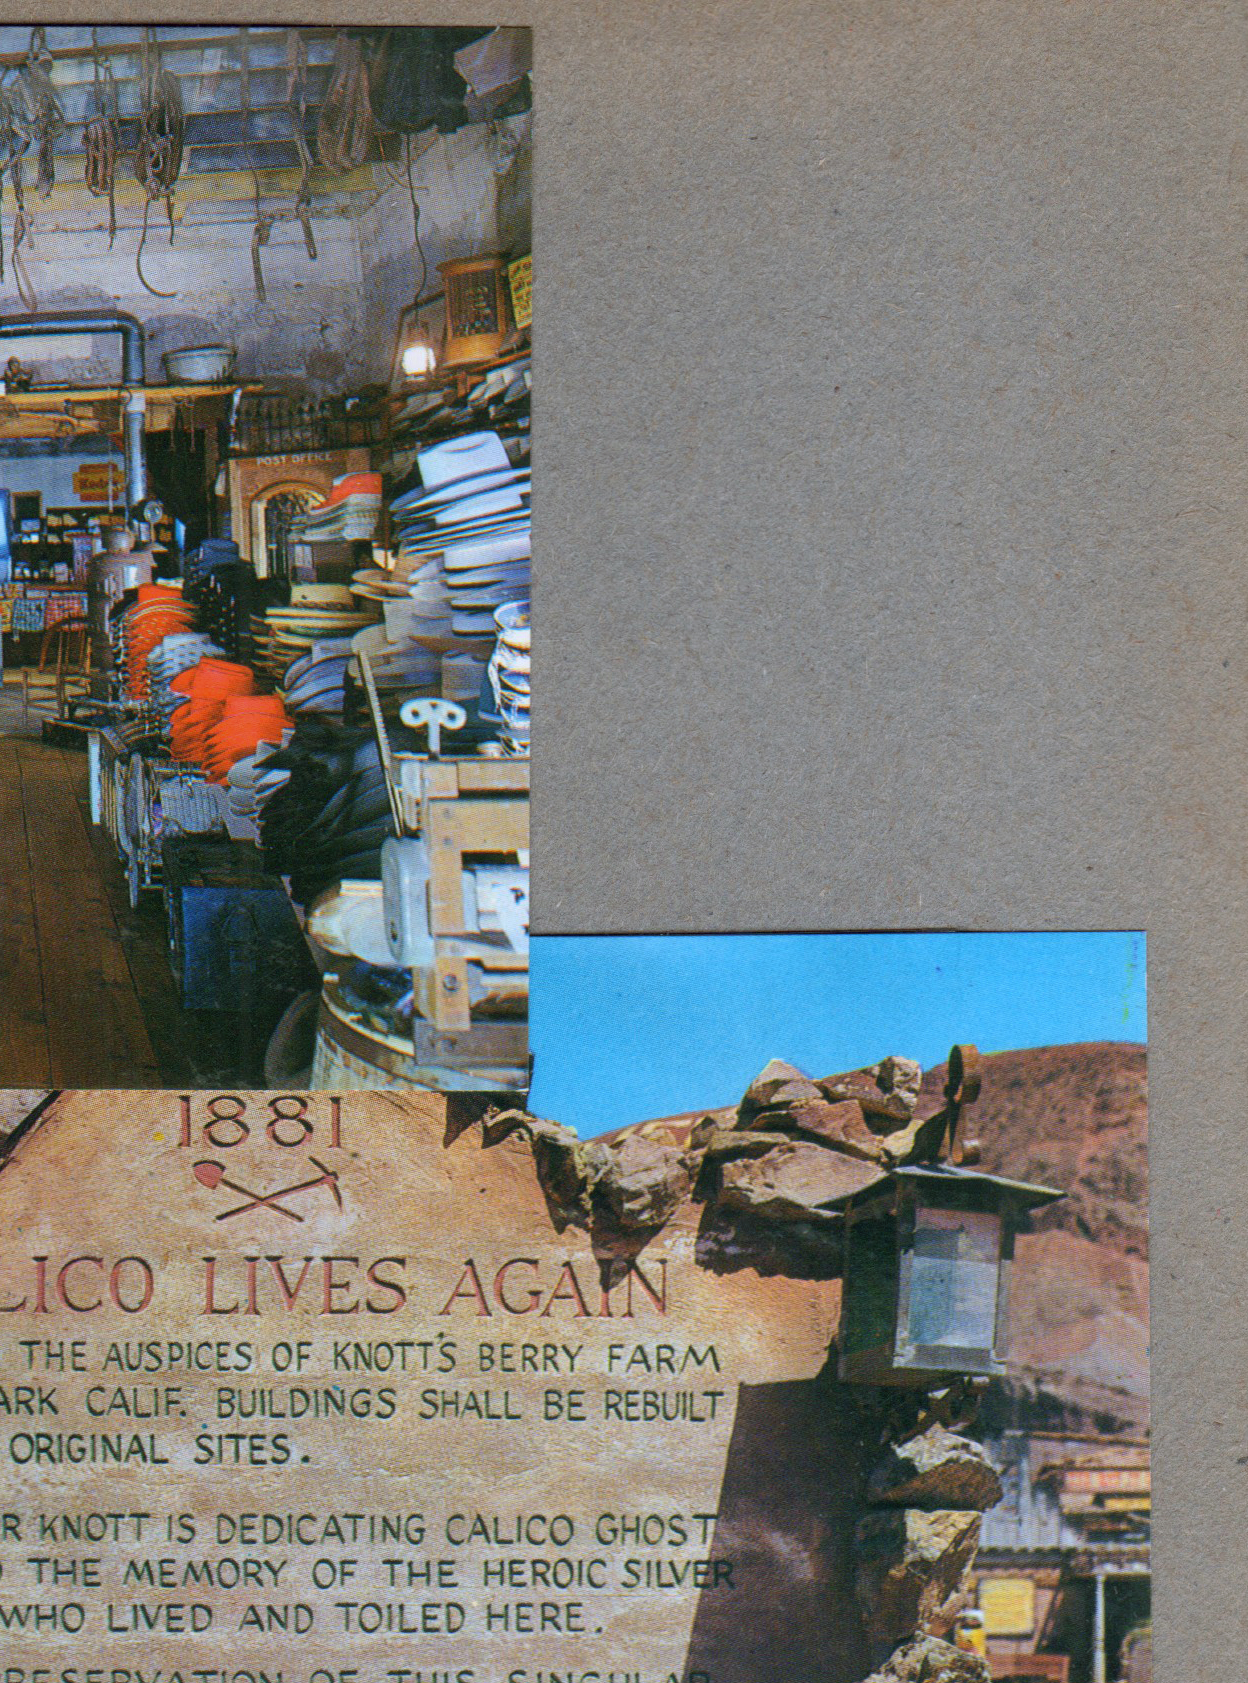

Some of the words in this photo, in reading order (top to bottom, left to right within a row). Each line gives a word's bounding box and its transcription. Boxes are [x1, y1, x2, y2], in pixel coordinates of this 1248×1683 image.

[256, 454, 287, 465] POST
[291, 451, 332, 463] OFFICE
[178, 1095, 342, 1148] 1881
[202, 1256, 407, 1316] LIVES
[439, 1258, 668, 1318] AGAIN
[19, 1340, 87, 1371] THE
[103, 1341, 253, 1372] AUSPICES
[272, 1342, 311, 1373] OF
[333, 1332, 456, 1374] KNOTT'S
[479, 1342, 580, 1374] BERRY
[607, 1343, 721, 1374] FARM
[86, 1386, 187, 1419] CALIF.
[217, 1386, 396, 1420] BUILDINGS
[419, 1389, 521, 1421] SHALL
[544, 1389, 586, 1421] BE
[605, 1390, 723, 1422] REBUILT
[11, 1434, 170, 1464] ORIGINAL
[195, 1433, 310, 1465] SITES.
[40, 1514, 151, 1543] KNOTT
[167, 1514, 196, 1544] IS
[215, 1514, 426, 1545] DEDICATING
[446, 1514, 574, 1545] CALICO
[596, 1514, 717, 1545] GHOST
[27, 1559, 101, 1587] THE
[123, 1559, 287, 1589] MEMORY
[313, 1560, 357, 1589] OF
[382, 1561, 459, 1589] THE
[484, 1560, 607, 1590] HEROIC
[622, 1561, 734, 1590] SILVER
[108, 1604, 212, 1633] LIVED
[238, 1604, 314, 1634] AND
[335, 1603, 465, 1633] TOILED
[486, 1603, 604, 1634] HERE.
